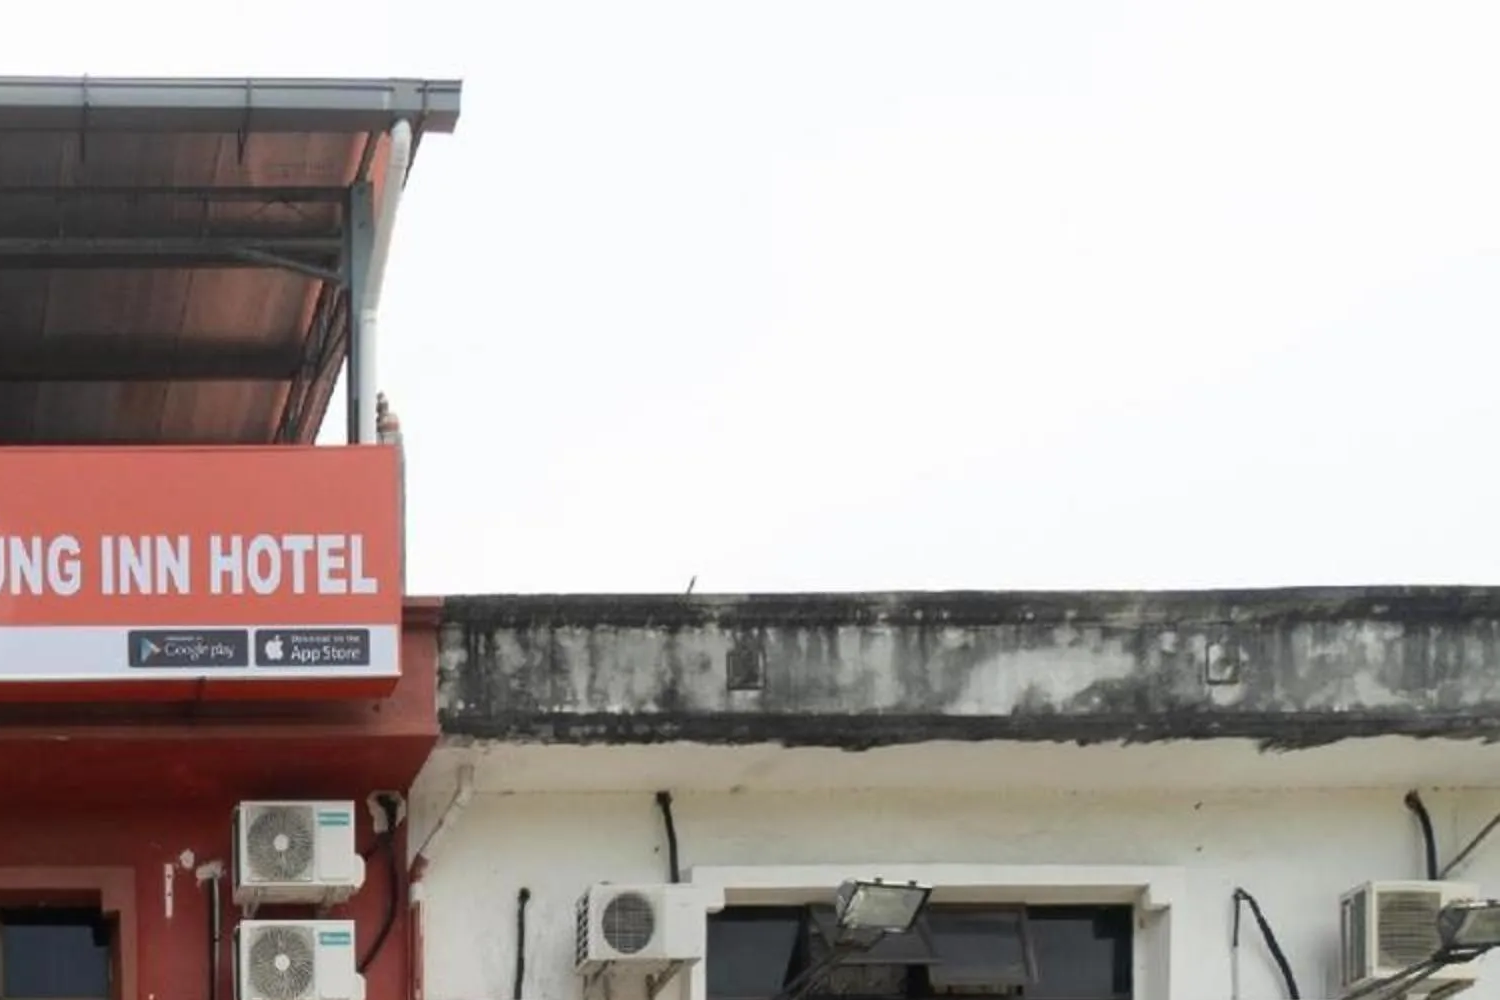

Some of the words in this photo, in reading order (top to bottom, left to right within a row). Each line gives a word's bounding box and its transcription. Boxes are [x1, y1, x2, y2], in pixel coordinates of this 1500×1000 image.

[101, 534, 190, 595] INN
[209, 533, 378, 595] HOTEL
[291, 645, 320, 663] App
[323, 645, 361, 661] Store
